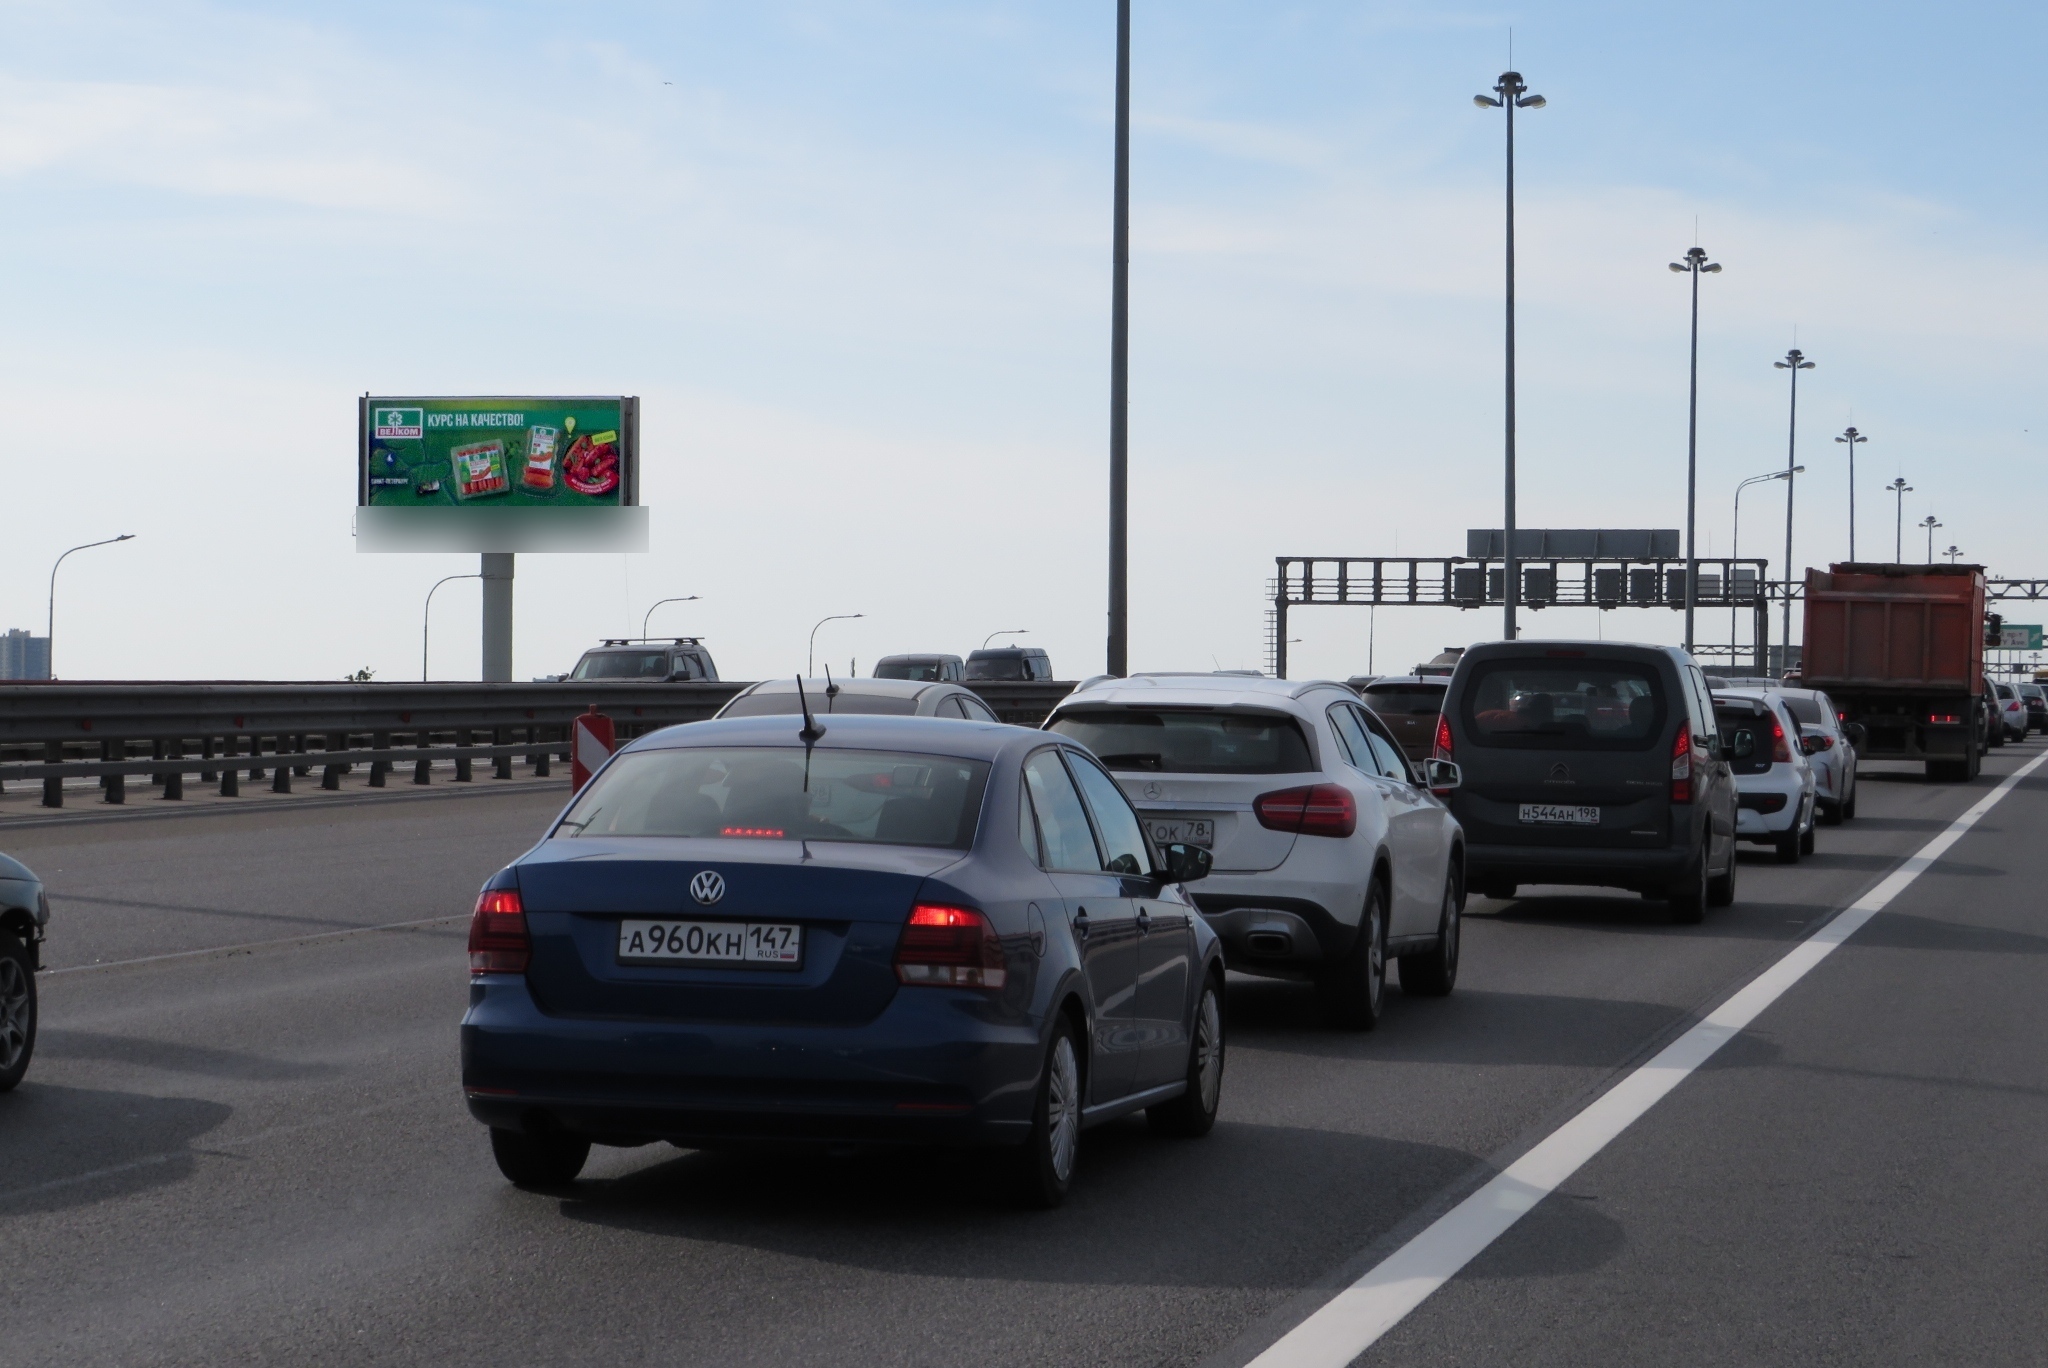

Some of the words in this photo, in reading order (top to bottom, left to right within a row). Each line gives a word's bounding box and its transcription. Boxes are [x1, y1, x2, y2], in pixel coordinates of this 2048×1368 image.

[427, 414, 453, 427] КУРС
[455, 414, 469, 427] НА
[471, 413, 524, 427] КАЧЕСТВО!
[1578, 807, 1598, 818] 198
[1187, 822, 1205, 836] 78
[628, 925, 742, 956] А960КН
[750, 927, 792, 949] 147
[757, 950, 779, 959] RUS
